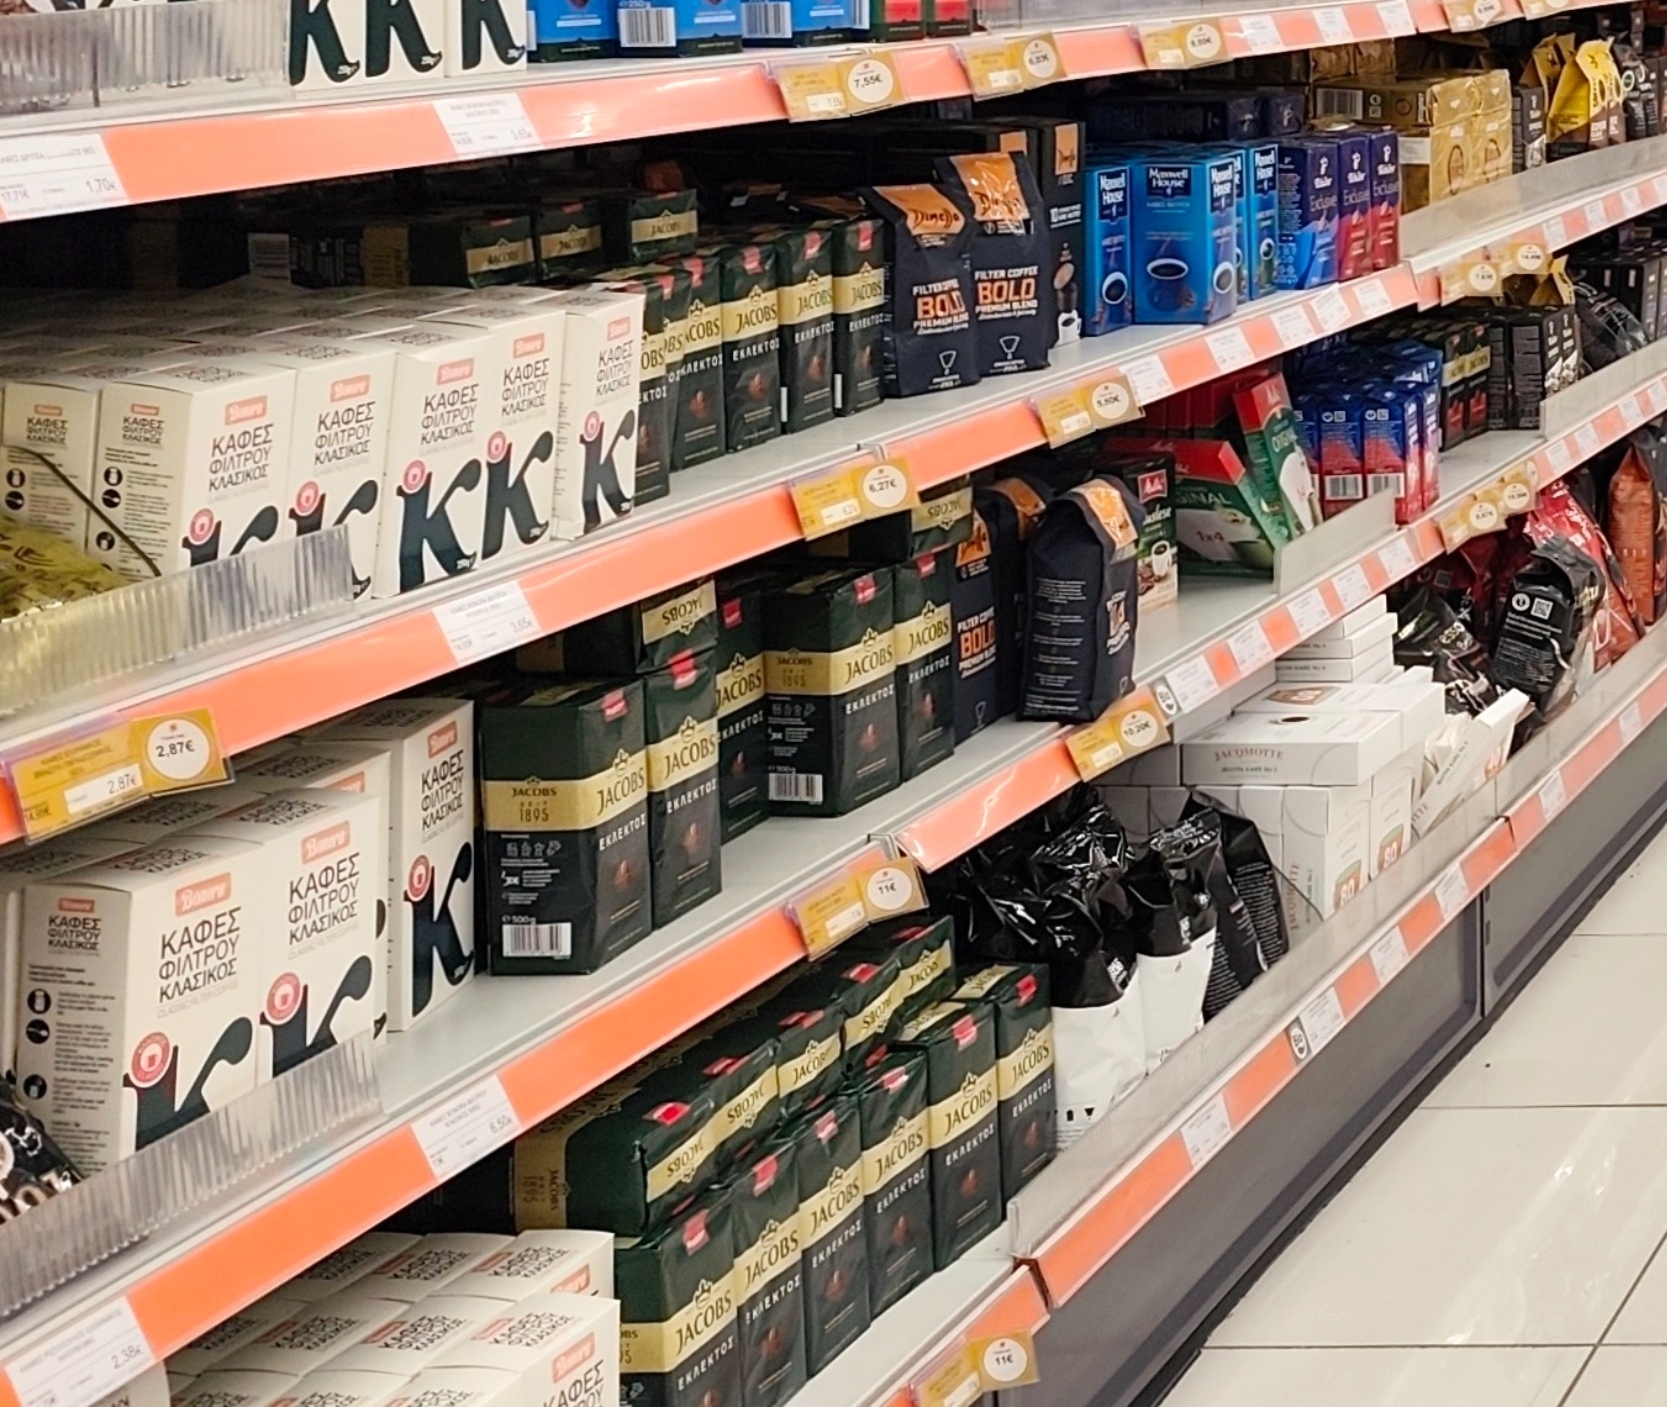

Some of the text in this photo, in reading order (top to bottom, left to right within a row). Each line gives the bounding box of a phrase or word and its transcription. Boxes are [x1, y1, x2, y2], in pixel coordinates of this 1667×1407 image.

[853, 75, 882, 89] 7,55€
[1152, 178, 1185, 189] House
[975, 266, 1038, 280] FILTER COFFEE
[977, 278, 1035, 303] BOLD
[736, 302, 777, 330] JACOBS
[917, 291, 966, 319] BOLD
[421, 404, 477, 429] ΦΙΛΤΡΟΥ
[423, 384, 479, 414] ΚΑΦΕΣ
[211, 423, 274, 458] ΚΑΦΕΣ
[420, 420, 475, 446] ΚΛΑΣΙΚΟΣ
[208, 464, 269, 492] ΚΛΑΣΙΚΟΣ
[209, 446, 272, 475] ΦΙΛΤΡΟΥ
[844, 643, 893, 683] JACOBS
[844, 684, 895, 715] ΕΚΛΕΚΤΟΣ
[155, 739, 196, 759] 2,87€
[663, 733, 717, 775] JACOBS
[107, 773, 137, 794] 2,87€
[597, 768, 647, 814] JACOBS
[666, 778, 718, 814] ΕΚΛΕΚΤΟΣ
[518, 807, 550, 823] 1895
[599, 812, 647, 852] ΕΚΛΕΚΤΟΣ
[290, 853, 360, 904] ΚΑΦΕΣ
[288, 879, 359, 925] ΦΙΛΤΡΟΥ
[161, 907, 241, 959] ΚΑΦΕΣ
[290, 901, 358, 945] ΚΛΑΣΙΚΟΣ
[159, 935, 239, 981] ΦΙΛΤΡΟΥ
[159, 958, 238, 1003] ΚΛΑΣΙΚΟΣ
[944, 1084, 993, 1137] JACOBS
[945, 1122, 995, 1167] ΕΚΛΕΚΤΟΣ
[809, 1175, 860, 1231] JACOBS
[812, 1219, 862, 1268] ΕΚΛΕΚΤΟΣ
[675, 1288, 732, 1353] JACOBS
[677, 1336, 735, 1391] ΕΚΛΕΚΤΟΣ
